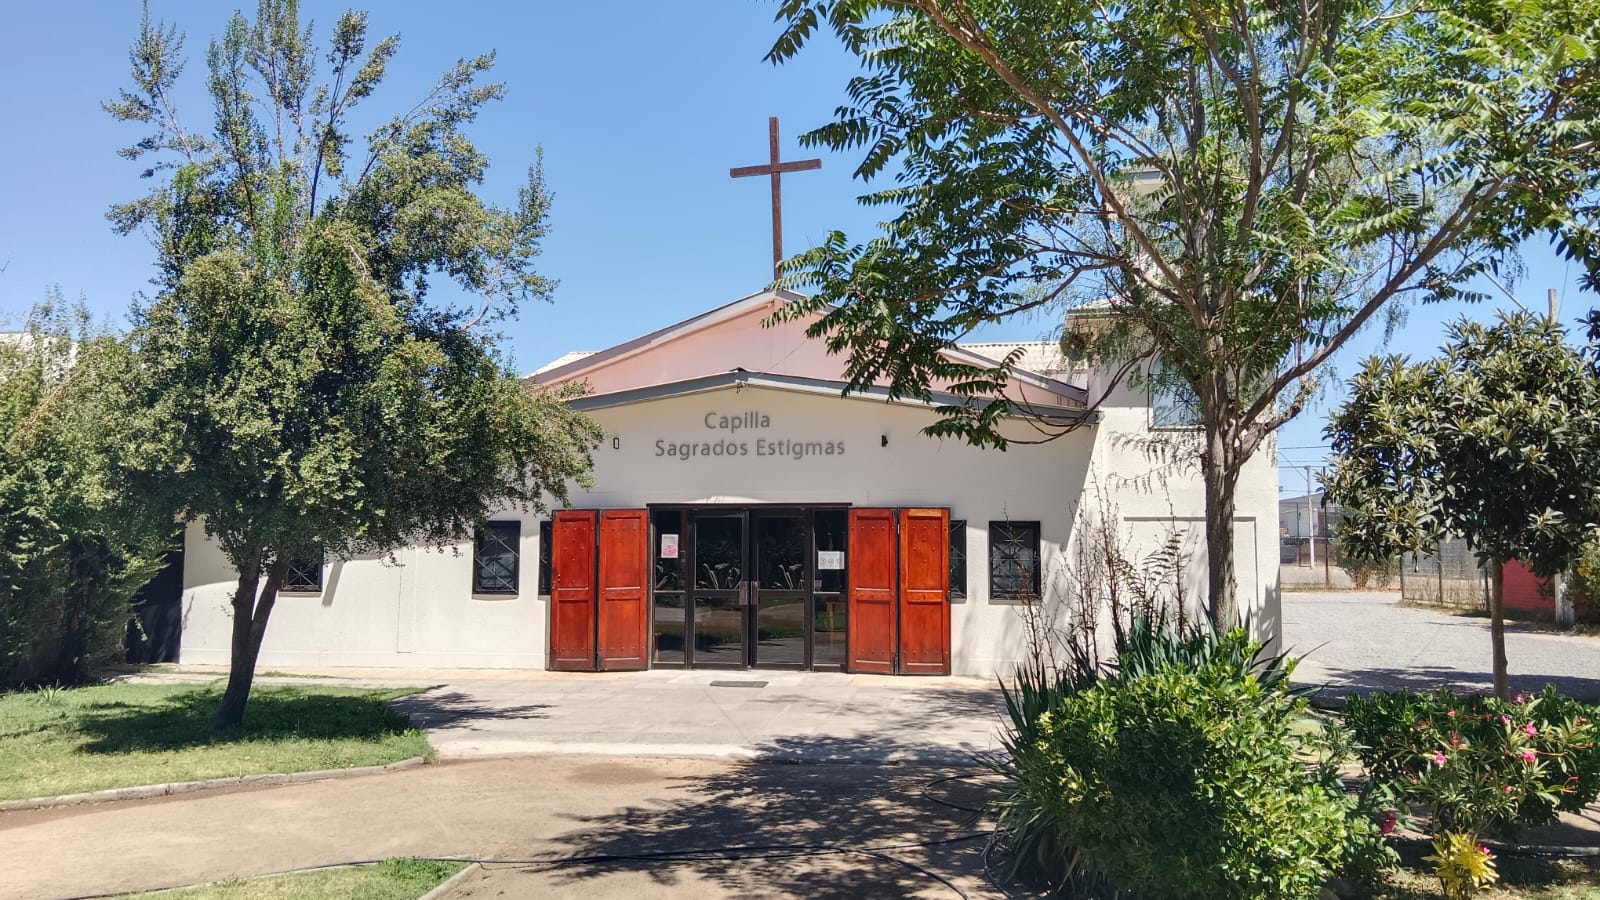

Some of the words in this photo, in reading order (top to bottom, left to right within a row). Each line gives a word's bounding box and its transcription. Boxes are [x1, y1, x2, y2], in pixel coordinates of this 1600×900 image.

[704, 411, 770, 433] Capilla
[655, 439, 748, 460] Sagrados
[756, 439, 845, 460] Estigmas
